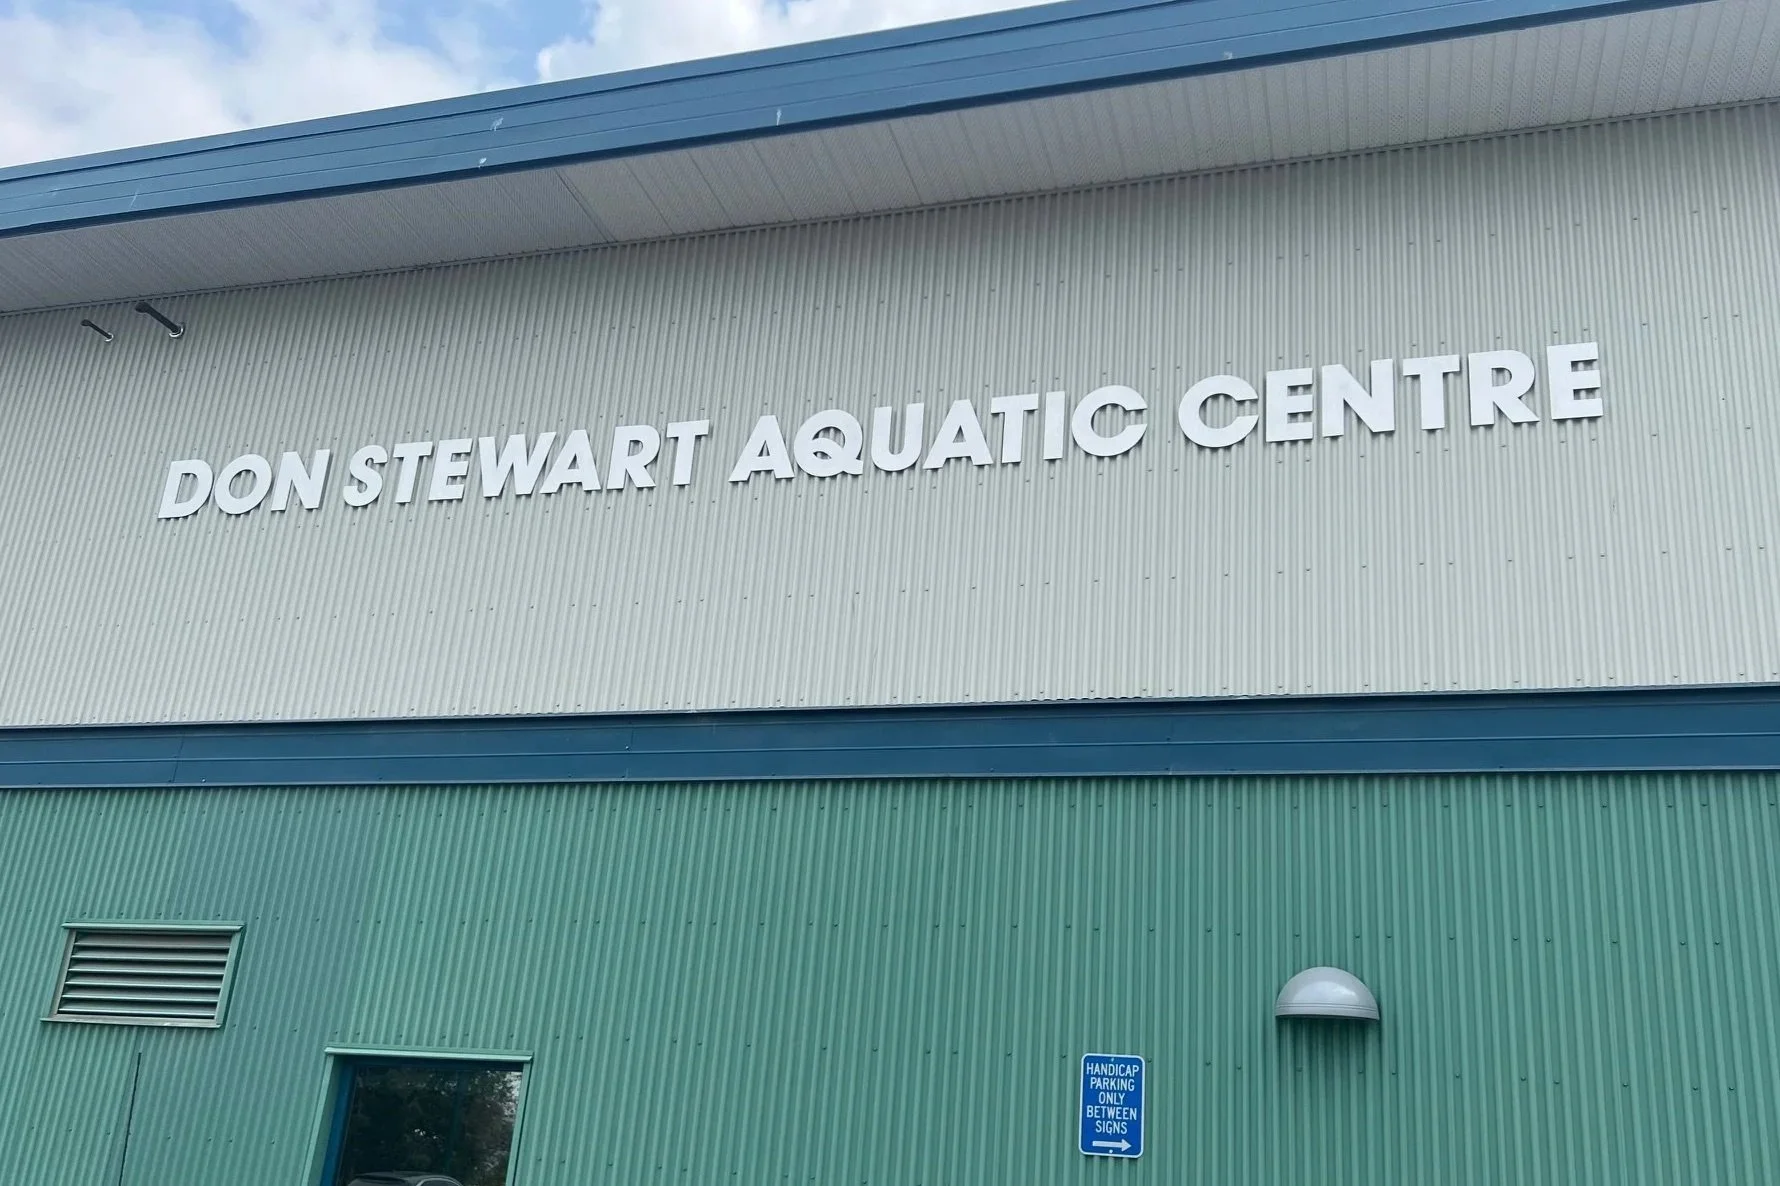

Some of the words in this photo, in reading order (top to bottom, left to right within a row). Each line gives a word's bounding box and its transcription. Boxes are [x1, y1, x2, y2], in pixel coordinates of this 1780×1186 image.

[158, 449, 332, 519] DON
[342, 419, 710, 507] STEWART
[728, 385, 1148, 482] AQUATIC
[1178, 342, 1603, 449] CENTRE
[1086, 1062, 1140, 1077] HANDICAP
[1090, 1076, 1135, 1091] PARKING
[1098, 1092, 1125, 1105] ONLY
[1086, 1105, 1137, 1120] BETWEEN
[1095, 1120, 1128, 1135] SIGNS
